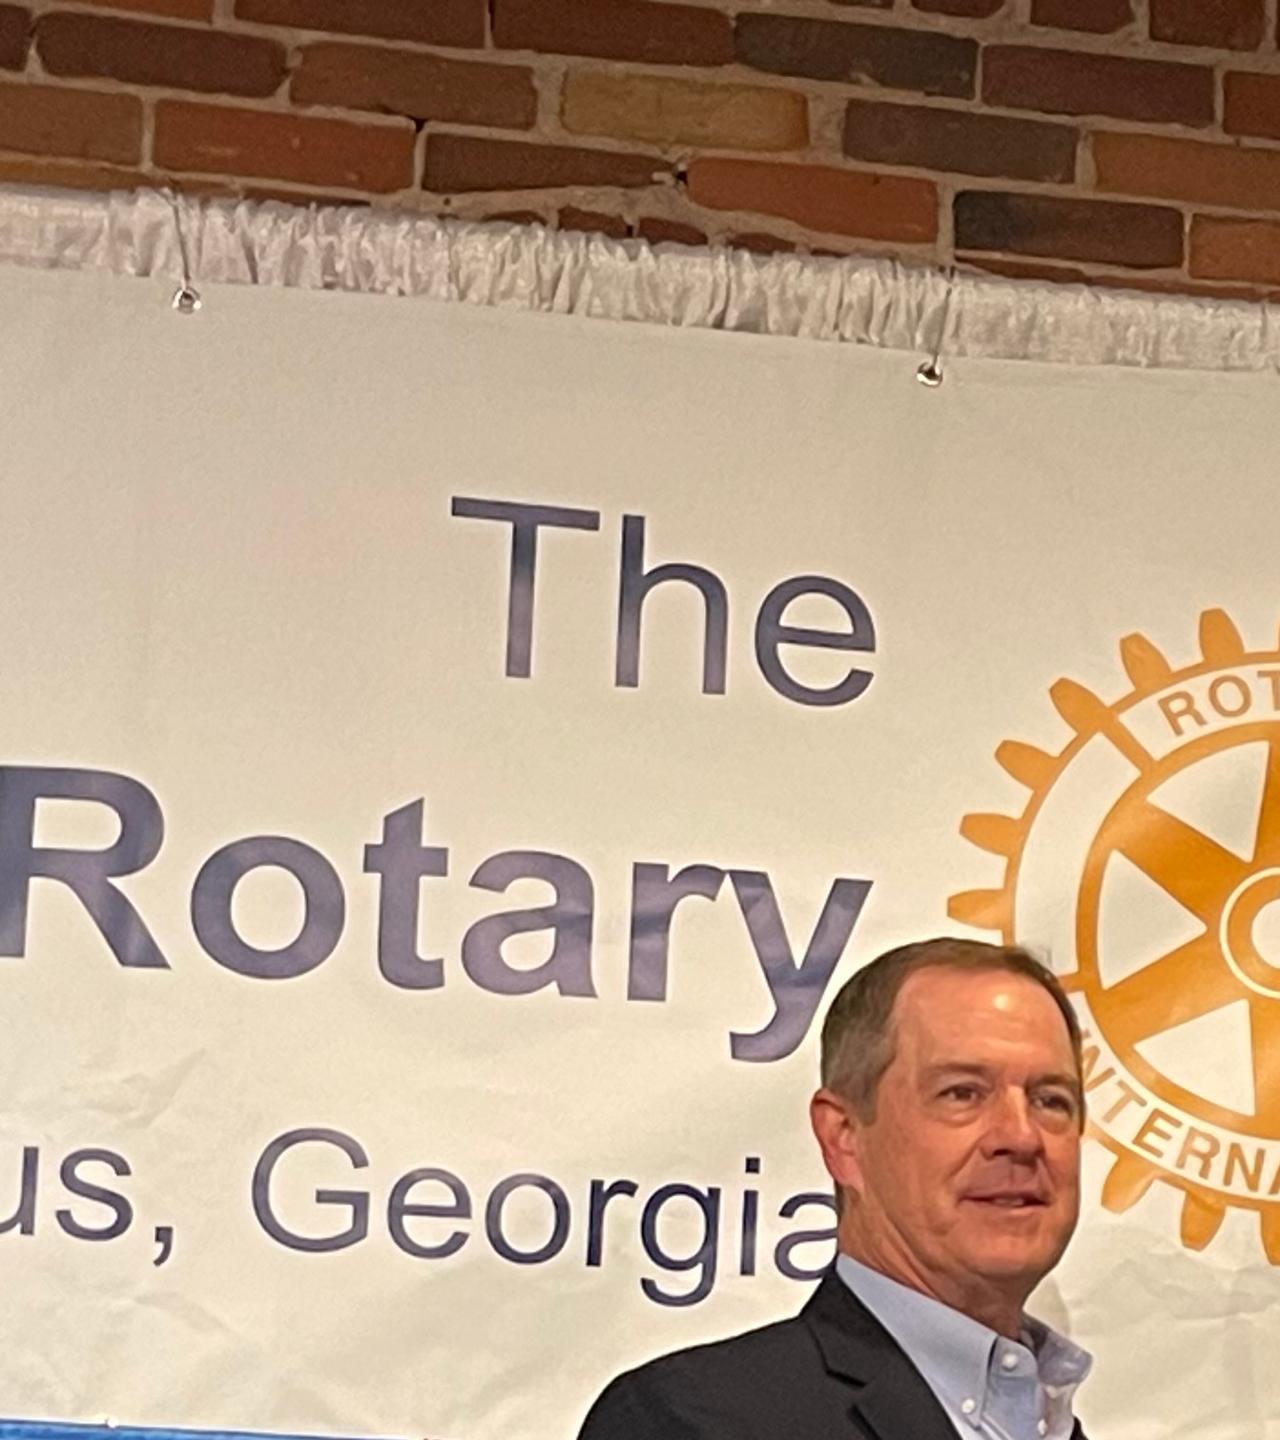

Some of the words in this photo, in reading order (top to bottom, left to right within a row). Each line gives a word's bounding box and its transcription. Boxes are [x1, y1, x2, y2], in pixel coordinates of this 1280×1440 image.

[451, 496, 876, 707] The
[0, 764, 875, 1063] Rotary
[252, 1127, 840, 1306] Georgia
